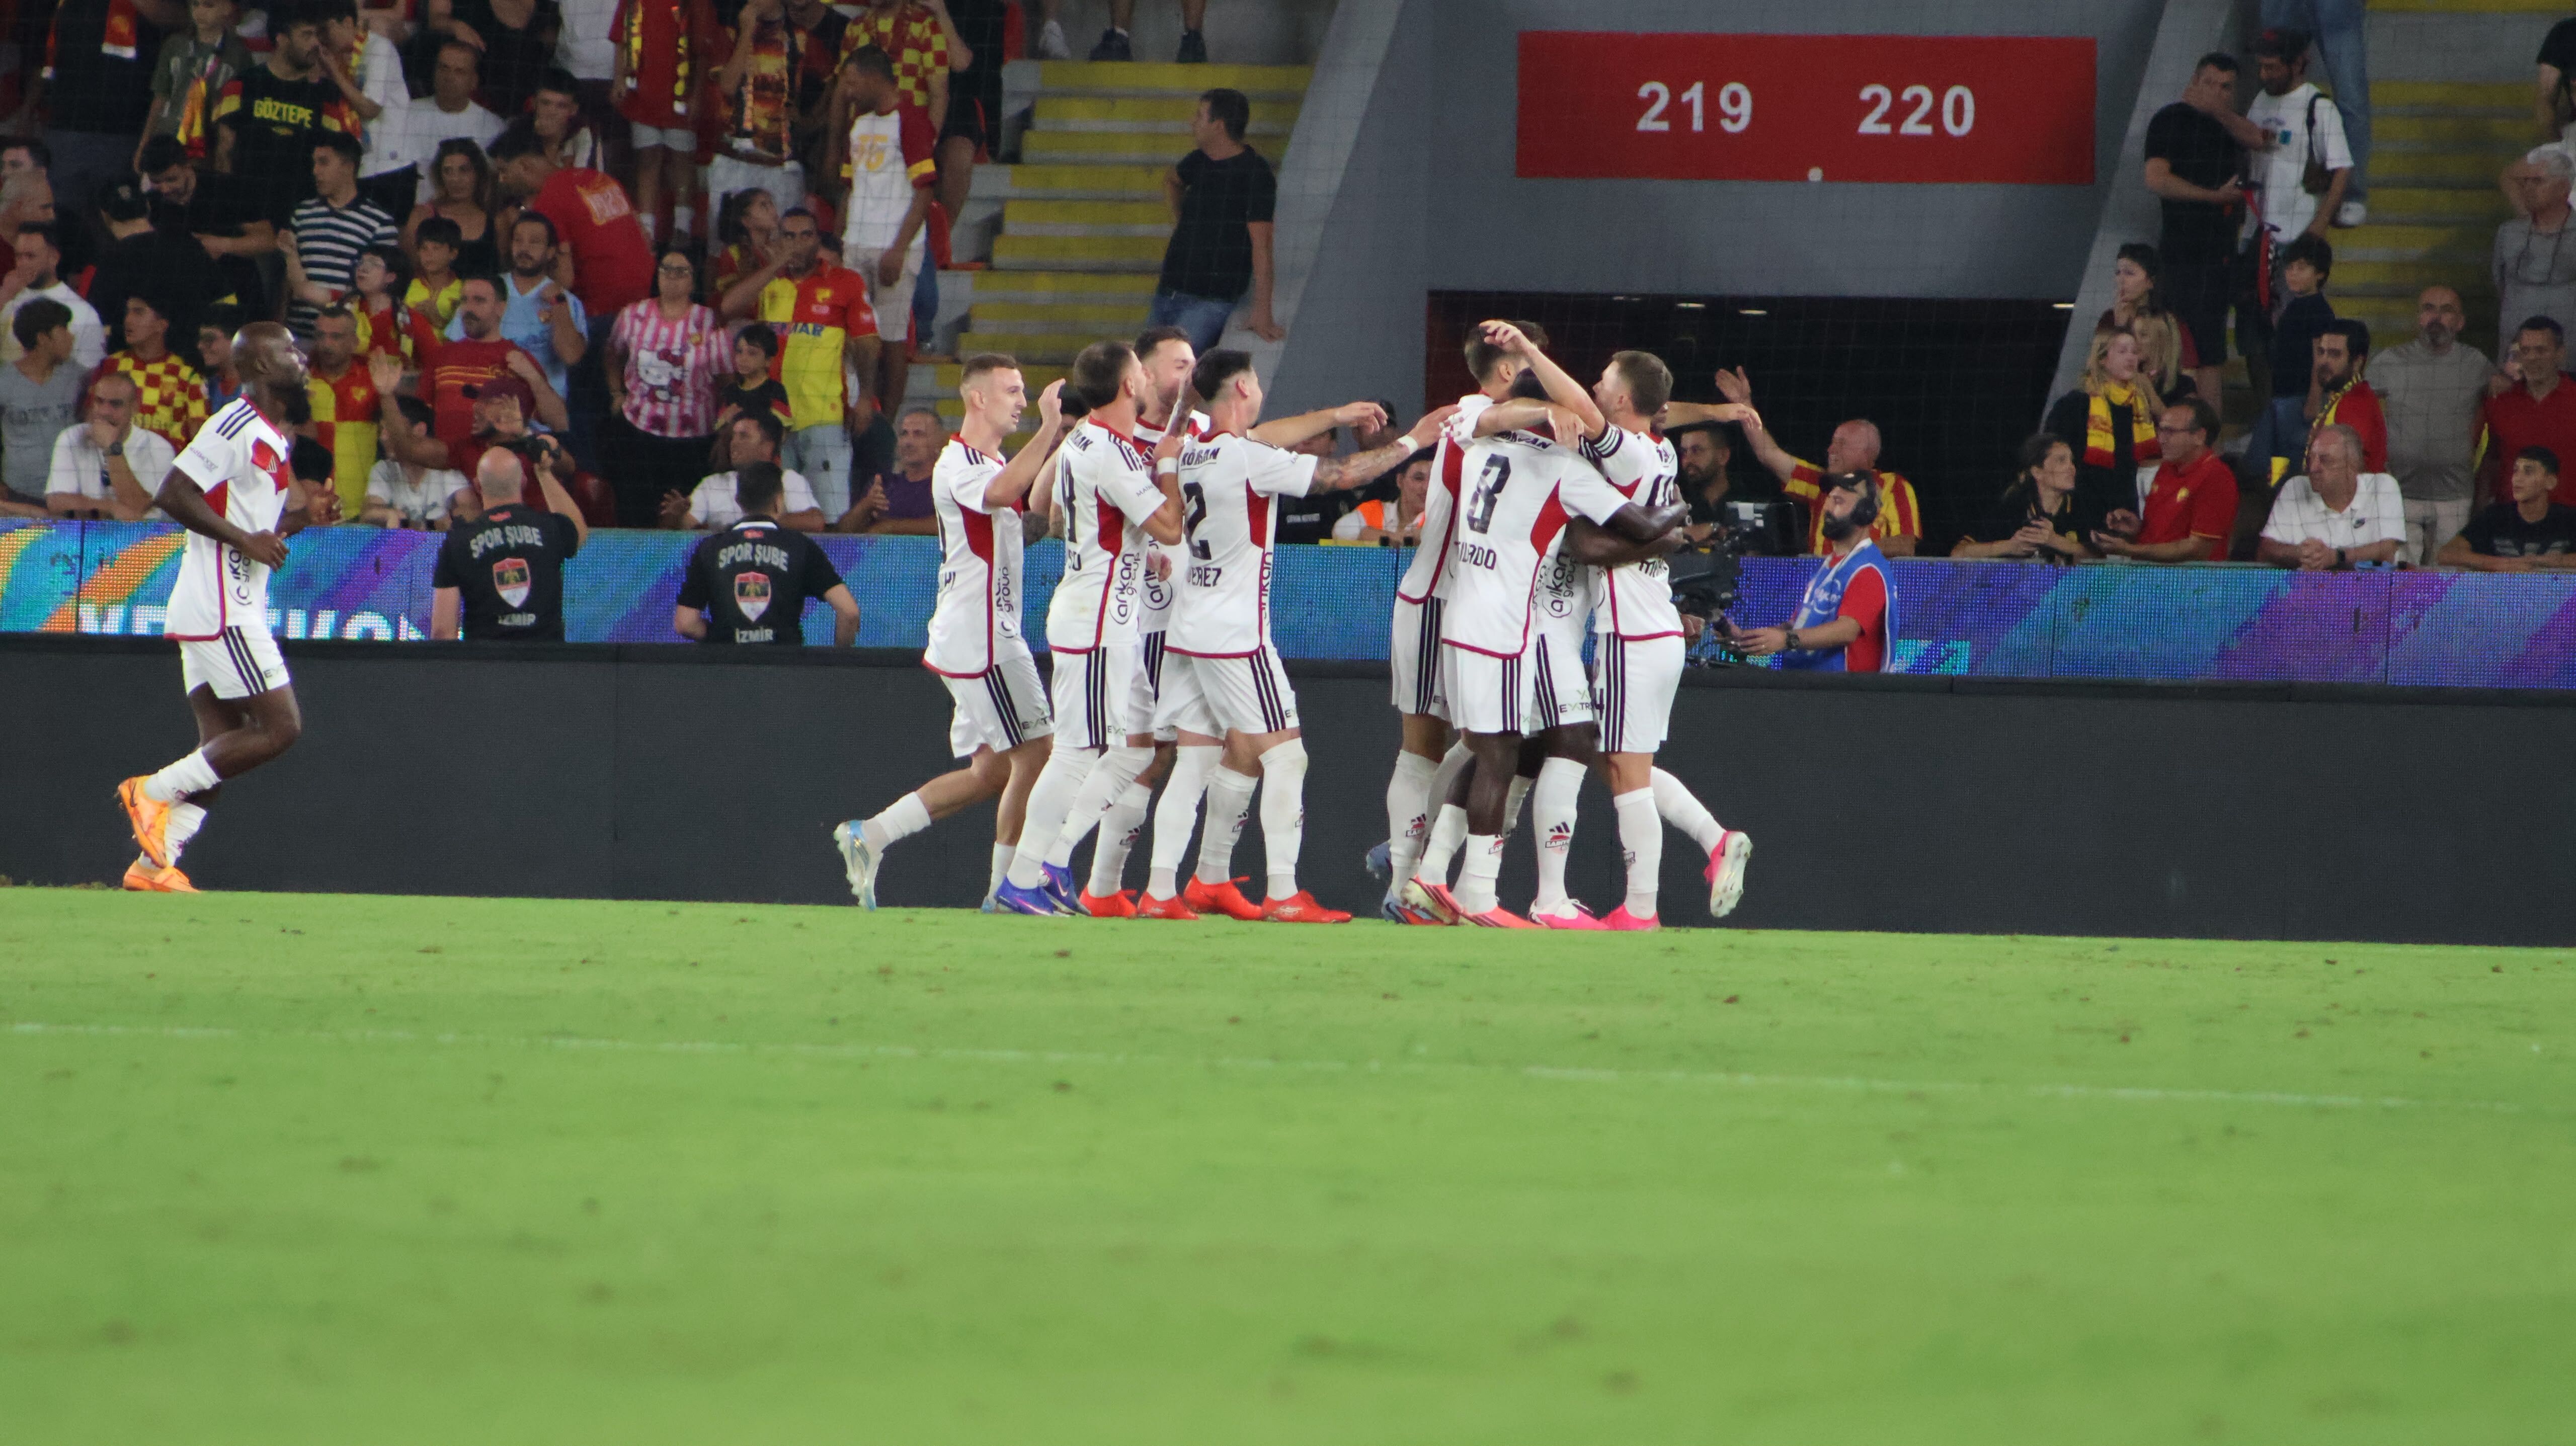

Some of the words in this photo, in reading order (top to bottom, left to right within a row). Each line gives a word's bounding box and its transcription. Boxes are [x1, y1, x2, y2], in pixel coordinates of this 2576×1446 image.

[1637, 81, 1752, 132] 219
[1858, 84, 1975, 137] 220
[1183, 481, 1212, 560] 2
[1467, 453, 1511, 534] 8
[470, 528, 504, 558] SPOR
[505, 525, 543, 547] ŞUBE
[719, 542, 753, 568] SPOR
[755, 544, 788, 572] ŞUBE
[1115, 553, 1135, 617] arkan
